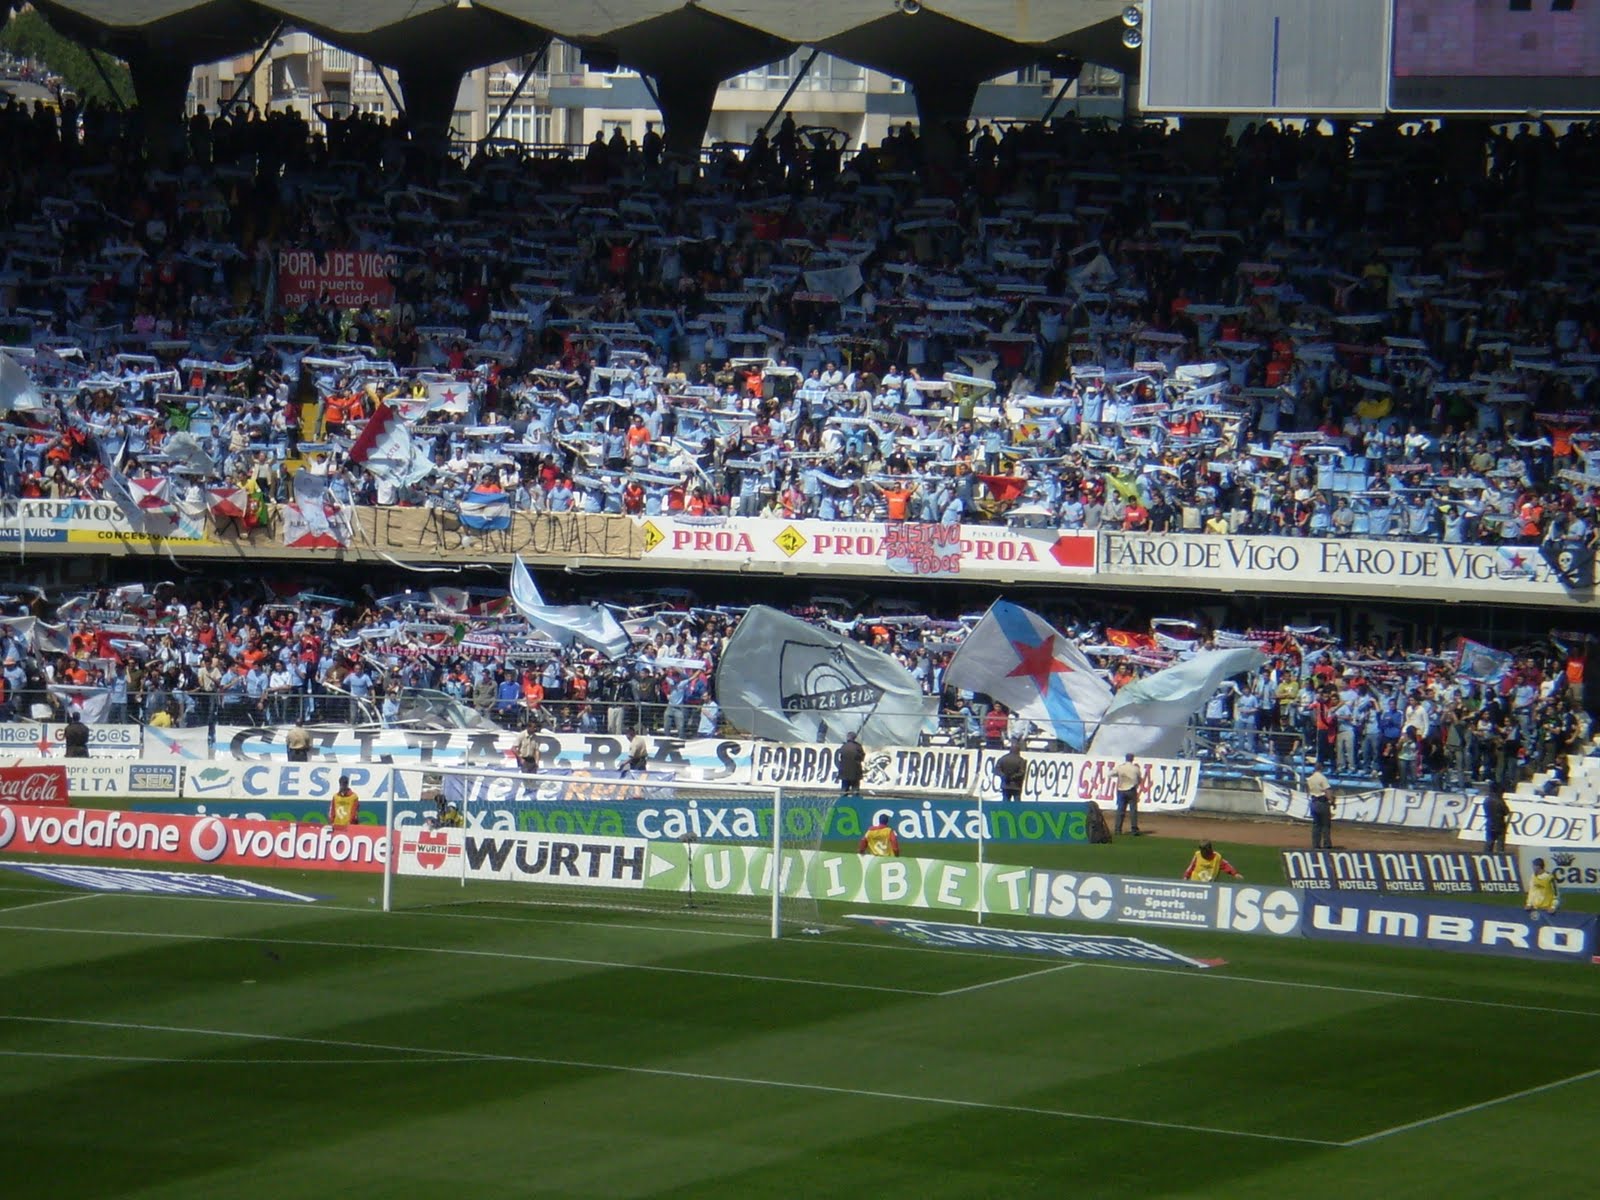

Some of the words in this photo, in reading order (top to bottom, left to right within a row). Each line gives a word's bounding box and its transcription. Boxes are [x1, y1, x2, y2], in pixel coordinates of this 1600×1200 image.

[335, 253, 354, 277] DE
[358, 253, 393, 278] VIGO
[299, 279, 315, 289] un
[320, 280, 364, 294] puerto
[285, 293, 307, 304] par
[334, 292, 378, 305] ciudad
[0, 502, 125, 521] NAREMOS
[373, 507, 403, 546] TE
[885, 523, 961, 548] GUSTAVO
[672, 530, 756, 552] PROA
[886, 542, 935, 559] SOMOS
[960, 539, 1039, 562] PROA
[907, 553, 961, 574] TODOS
[1104, 534, 1180, 568] FARO
[1182, 541, 1221, 569] DE
[1225, 538, 1300, 572] VIGO
[1319, 542, 1396, 576] FARO
[1399, 549, 1438, 578] DE
[92, 766, 111, 774] con
[115, 765, 124, 774] el
[131, 773, 174, 788] SER
[896, 750, 970, 790] TROIKA
[67, 777, 118, 791] ELTA
[242, 766, 410, 799] CESPA
[636, 800, 862, 839] caixanova
[872, 800, 1088, 841] caixanova
[1543, 815, 1587, 842] DE
[21, 810, 181, 852] vodafone
[232, 823, 391, 864] vodafone
[417, 844, 448, 854] WÜRTH
[465, 836, 646, 882] WÜRTH
[703, 850, 1028, 911] UNIBET
[1292, 879, 1331, 890] HOTELES
[1338, 880, 1378, 891] HOTELES
[1552, 866, 1600, 884] cas
[1033, 873, 1113, 920] ISO
[1124, 884, 1209, 900] International
[1386, 881, 1425, 892] HOTELES
[1433, 881, 1472, 893] HOTELES
[1481, 882, 1520, 893] HOTELES
[1123, 905, 1206, 922] Organization
[1145, 897, 1186, 910] Sports
[1216, 887, 1300, 935] ISO
[905, 922, 1174, 961] Groupama
